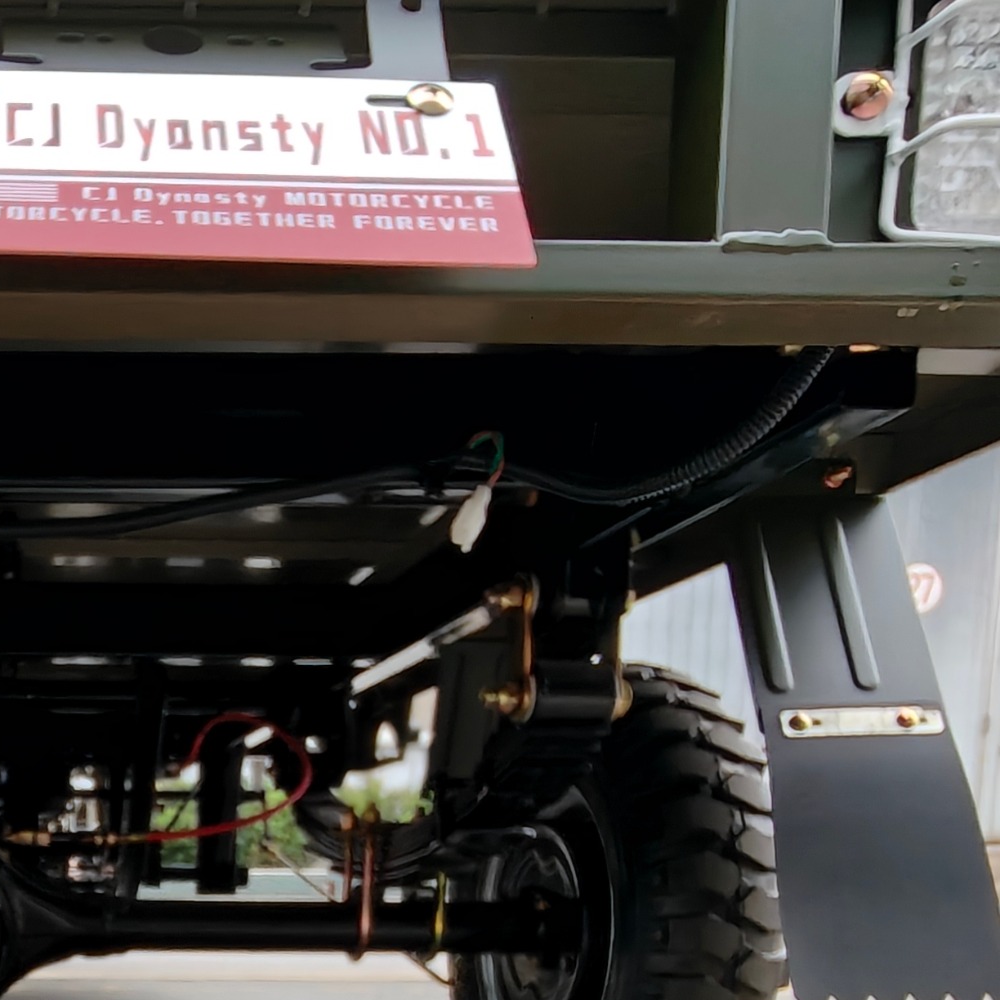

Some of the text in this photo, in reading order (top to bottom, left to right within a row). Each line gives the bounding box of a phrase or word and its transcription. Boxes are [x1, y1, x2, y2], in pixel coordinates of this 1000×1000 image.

[6, 102, 61, 147] CJ
[81, 186, 495, 210] CJ Dynasty MOTORCYCLE
[352, 214, 500, 233] FOREVER
